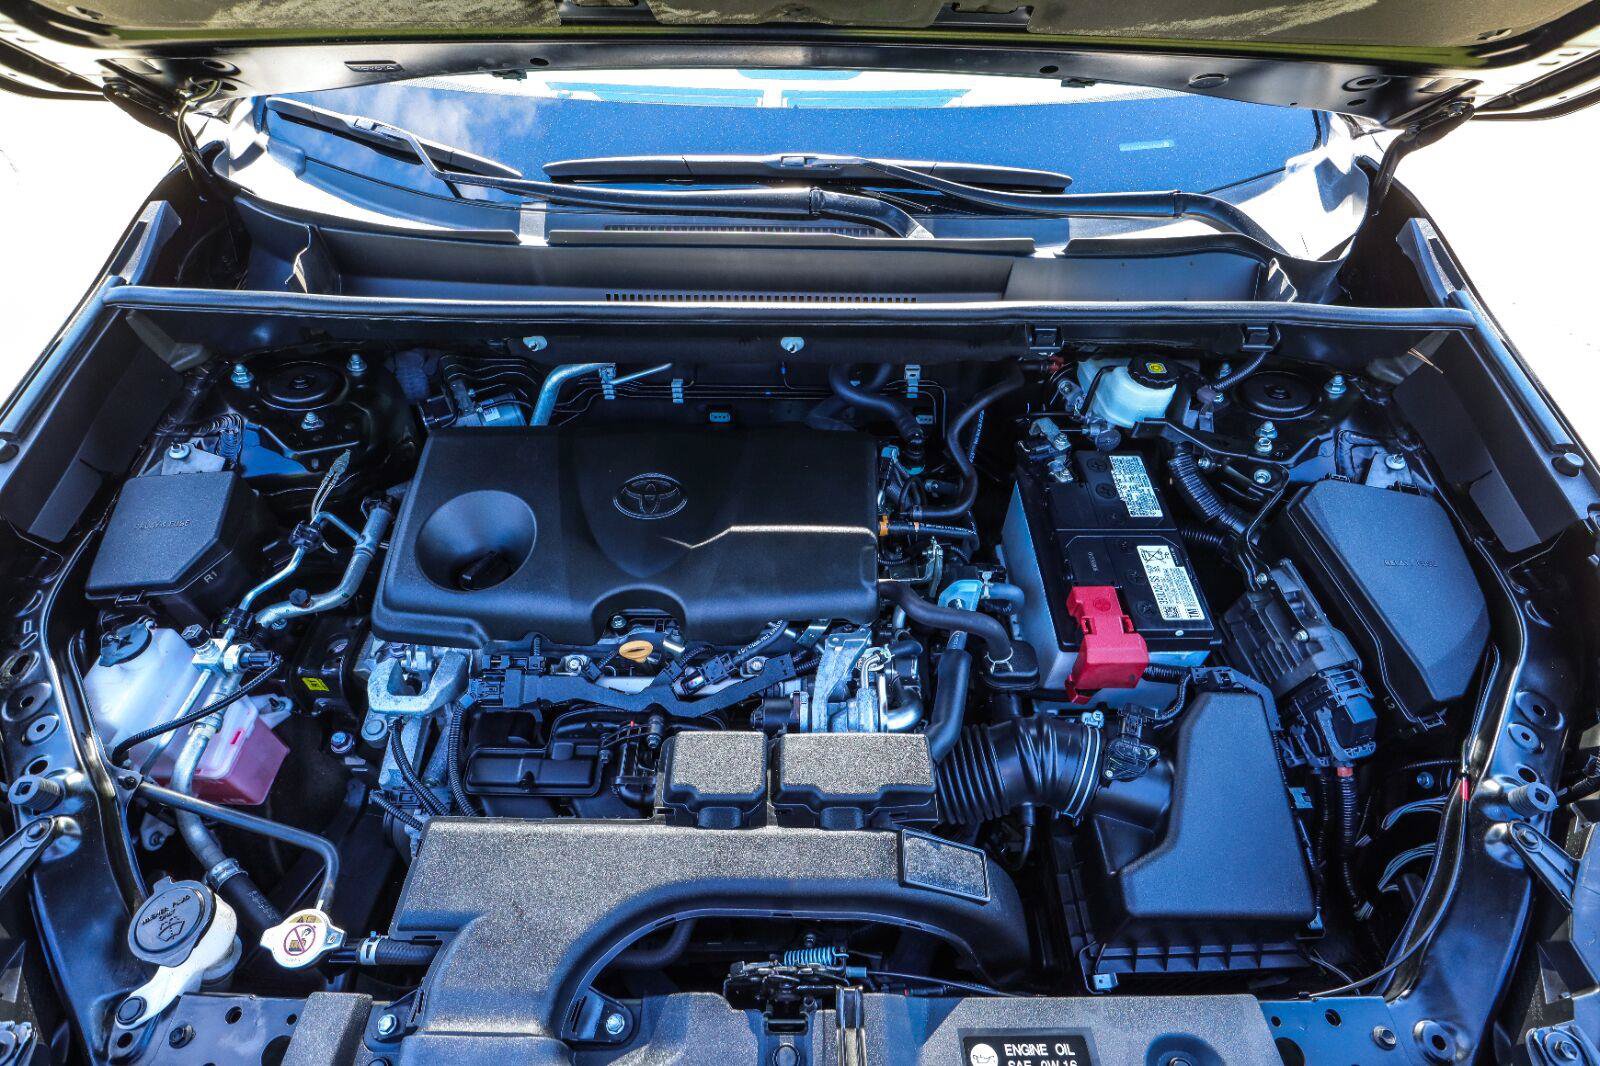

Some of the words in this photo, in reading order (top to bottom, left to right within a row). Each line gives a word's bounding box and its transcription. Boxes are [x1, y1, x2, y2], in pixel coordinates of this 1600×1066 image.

[203, 570, 218, 584] R1
[1004, 1043, 1048, 1056] ENGINE
[1055, 1043, 1076, 1056] OIL
